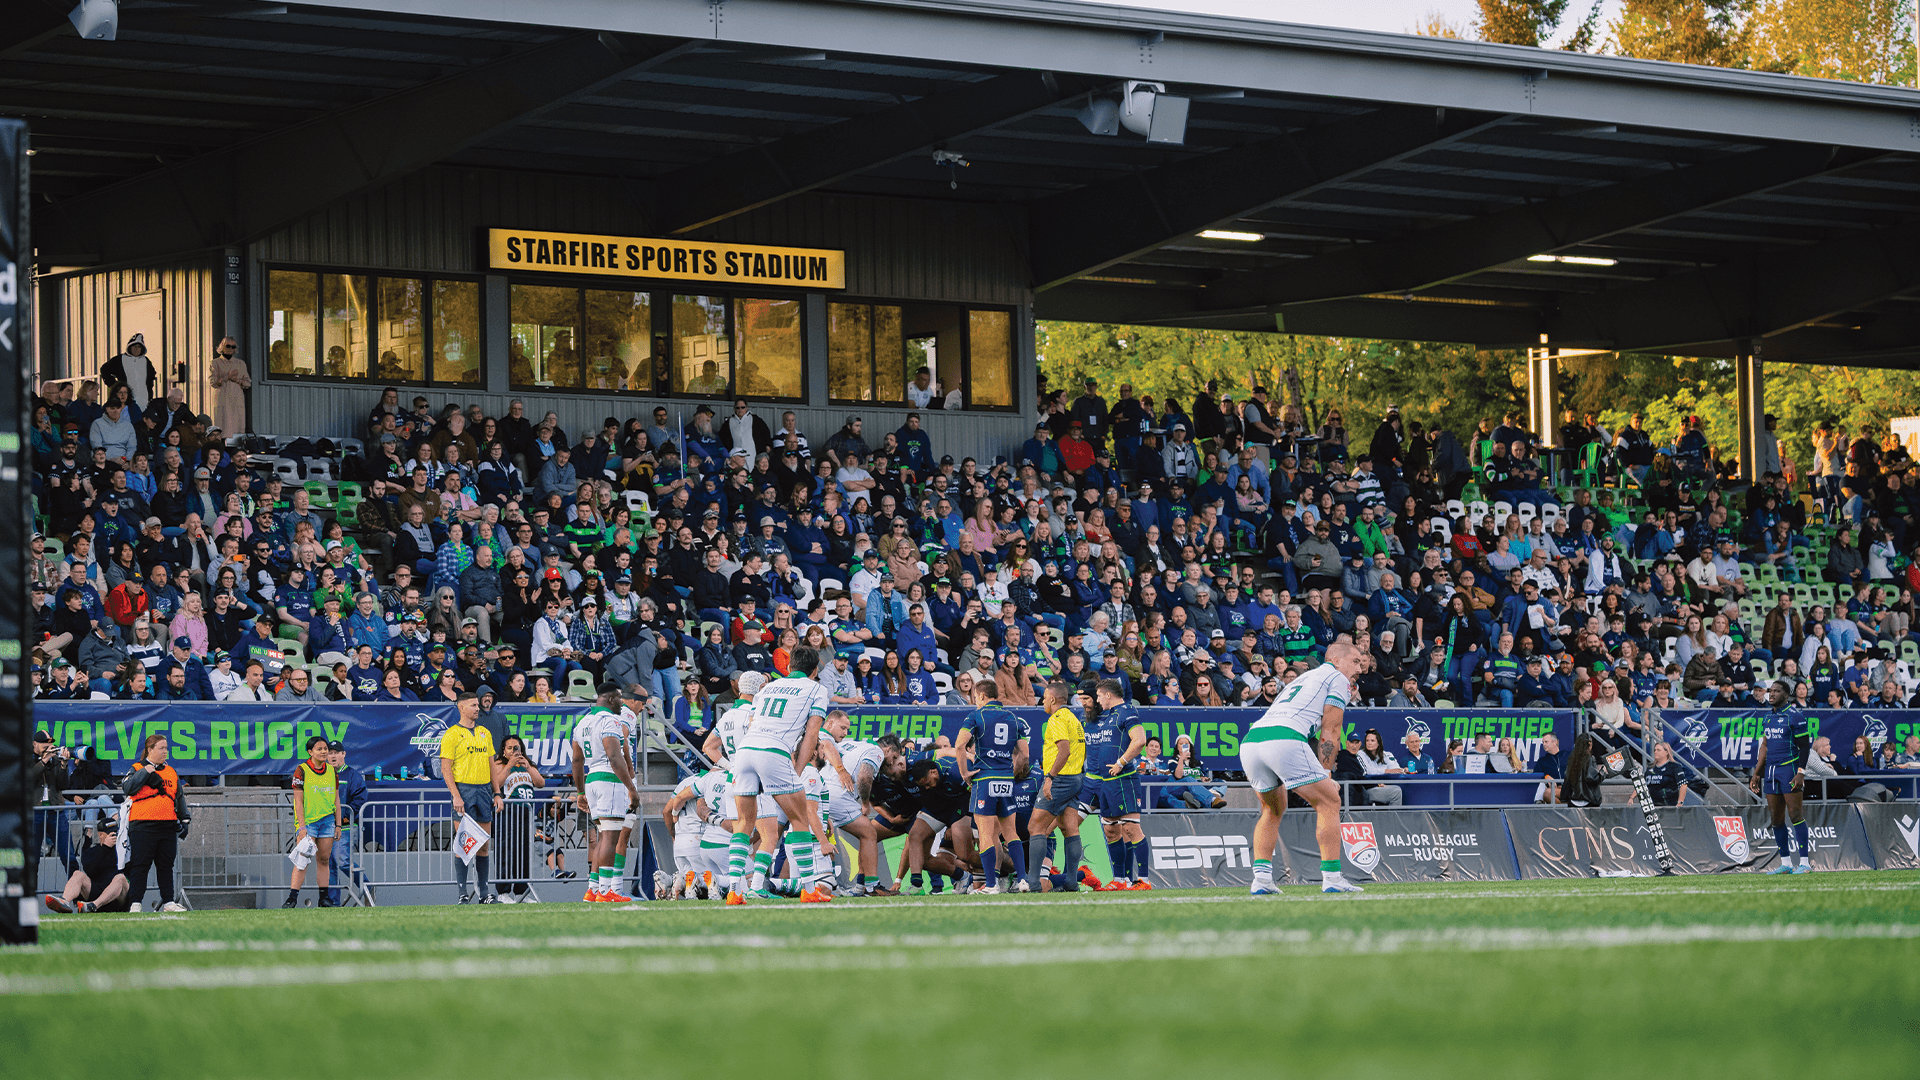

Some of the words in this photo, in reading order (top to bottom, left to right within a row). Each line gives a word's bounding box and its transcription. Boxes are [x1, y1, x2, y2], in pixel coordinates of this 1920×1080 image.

[228, 256, 240, 264] 103
[507, 237, 619, 269] STARFIRE
[626, 244, 717, 275] SPORTS
[725, 251, 827, 282] STADIUM
[1279, 685, 1304, 704] 3
[760, 697, 788, 719] 10
[995, 723, 1009, 745] 9
[584, 740, 593, 758] 8
[1720, 737, 1753, 761] WE
[992, 784, 1011, 794] USI
[1342, 825, 1374, 841] MLR
[1717, 819, 1742, 833] MLR
[1753, 827, 1794, 840] MAJR
[1384, 834, 1430, 847] MAJOR
[1432, 834, 1478, 846] LEAGUE
[1538, 826, 1635, 861] CTMS
[1150, 835, 1251, 869] ESPN
[1413, 848, 1454, 861] RUGBY
